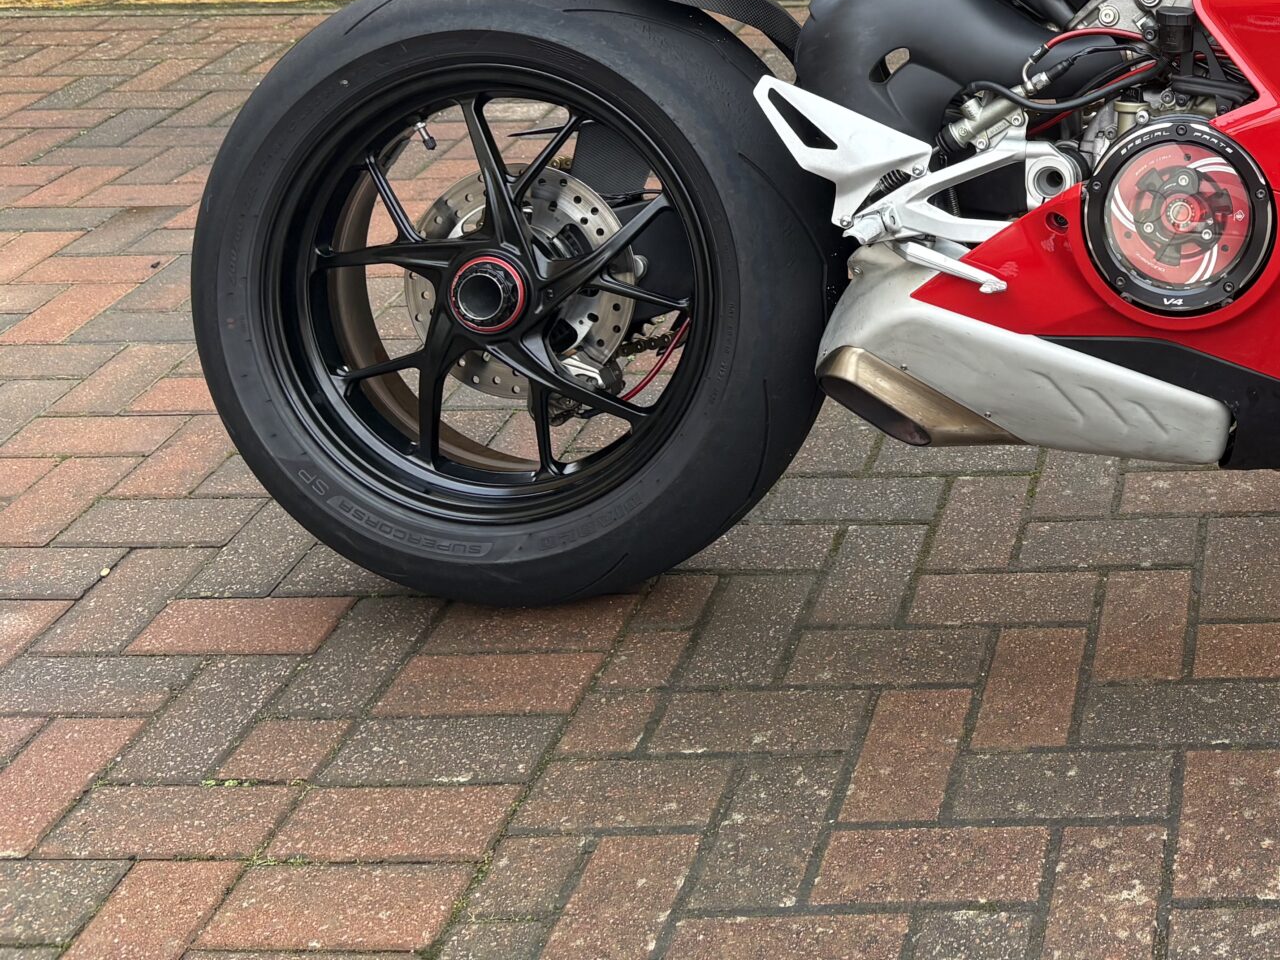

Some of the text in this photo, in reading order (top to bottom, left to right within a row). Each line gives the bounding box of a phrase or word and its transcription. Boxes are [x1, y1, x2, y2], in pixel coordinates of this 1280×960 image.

[1120, 131, 1234, 156] SPECIAL PARTS
[1163, 297, 1184, 306] V4
[298, 468, 483, 556] SUPERCORSA SP
